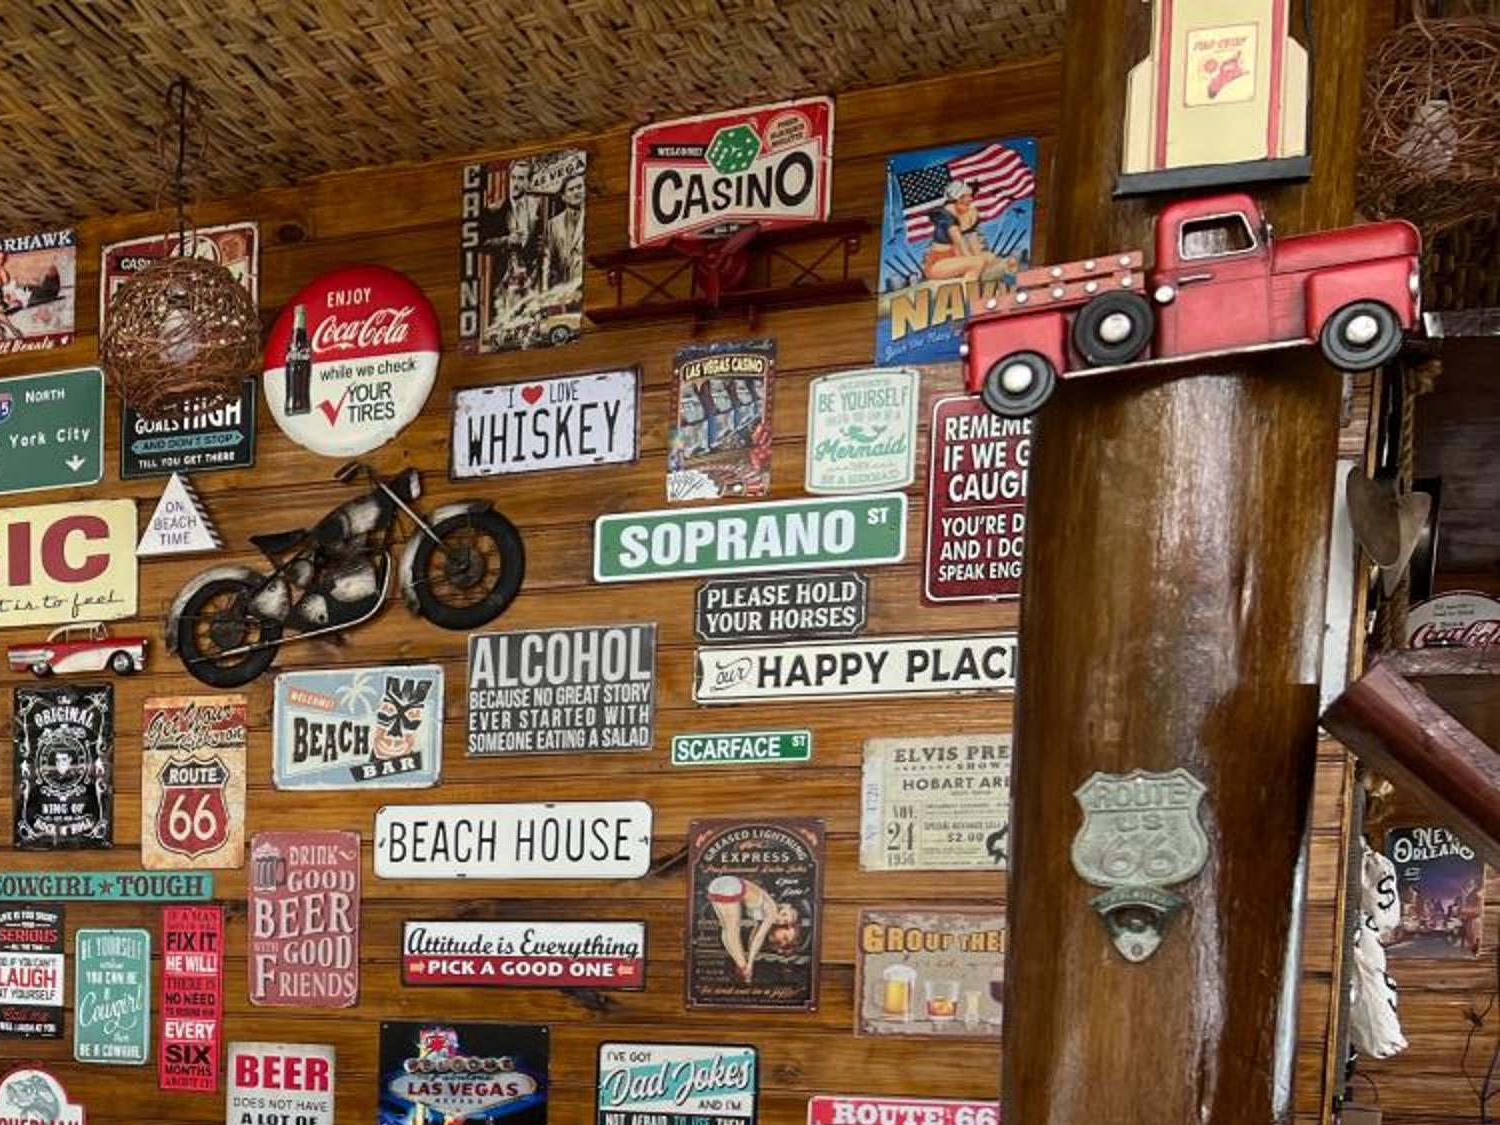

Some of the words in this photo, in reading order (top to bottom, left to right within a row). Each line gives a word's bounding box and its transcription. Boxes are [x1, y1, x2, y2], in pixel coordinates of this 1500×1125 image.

[652, 152, 814, 223] CASINO
[327, 289, 371, 308] ENJOY
[320, 364, 352, 381] while
[356, 368, 376, 378] we
[378, 358, 416, 375] check
[348, 382, 392, 402] YOUR
[507, 389, 514, 408] I
[550, 381, 579, 401] LOVE
[347, 401, 395, 422] TIRES
[9, 430, 45, 448] York
[55, 426, 92, 448] City
[468, 401, 619, 468] WHISKEY
[166, 501, 183, 513] ON
[154, 516, 197, 531] BEACH
[160, 532, 190, 545] TIME
[619, 509, 855, 568] SOPRANO
[867, 507, 889, 524] ST
[706, 586, 790, 608] PLEASE
[796, 581, 856, 603] HOLD
[706, 611, 763, 633] YOUR
[770, 607, 856, 630] HORSES
[470, 629, 651, 687] ALCOHOL
[756, 651, 888, 689] HAPPY
[470, 689, 531, 709] BECAUSE
[534, 690, 553, 707] NO
[556, 686, 601, 704] GREAT
[604, 683, 651, 702] STORY
[470, 711, 513, 731] EVER
[519, 708, 596, 729] STARTED
[604, 706, 650, 726] WITH
[469, 734, 533, 753] SOMEONE
[537, 731, 585, 750] EATING
[588, 732, 598, 748] A
[601, 728, 649, 748] SALAD
[677, 736, 780, 761] SCARFACE
[792, 735, 806, 746] ST
[168, 766, 220, 784] ROUTE
[167, 802, 219, 841] 66
[390, 819, 496, 863] BEACH
[515, 817, 632, 862] HOUSE
[116, 876, 205, 897] TOUGH
[408, 927, 494, 956] Attitude
[497, 933, 515, 955] is
[516, 928, 640, 960] Everything
[428, 959, 476, 977] PICK
[480, 961, 495, 977] A
[500, 961, 563, 977] GOOD
[574, 962, 614, 977] ONE
[602, 1061, 671, 1106] Dad
[672, 1055, 751, 1106] Jokes
